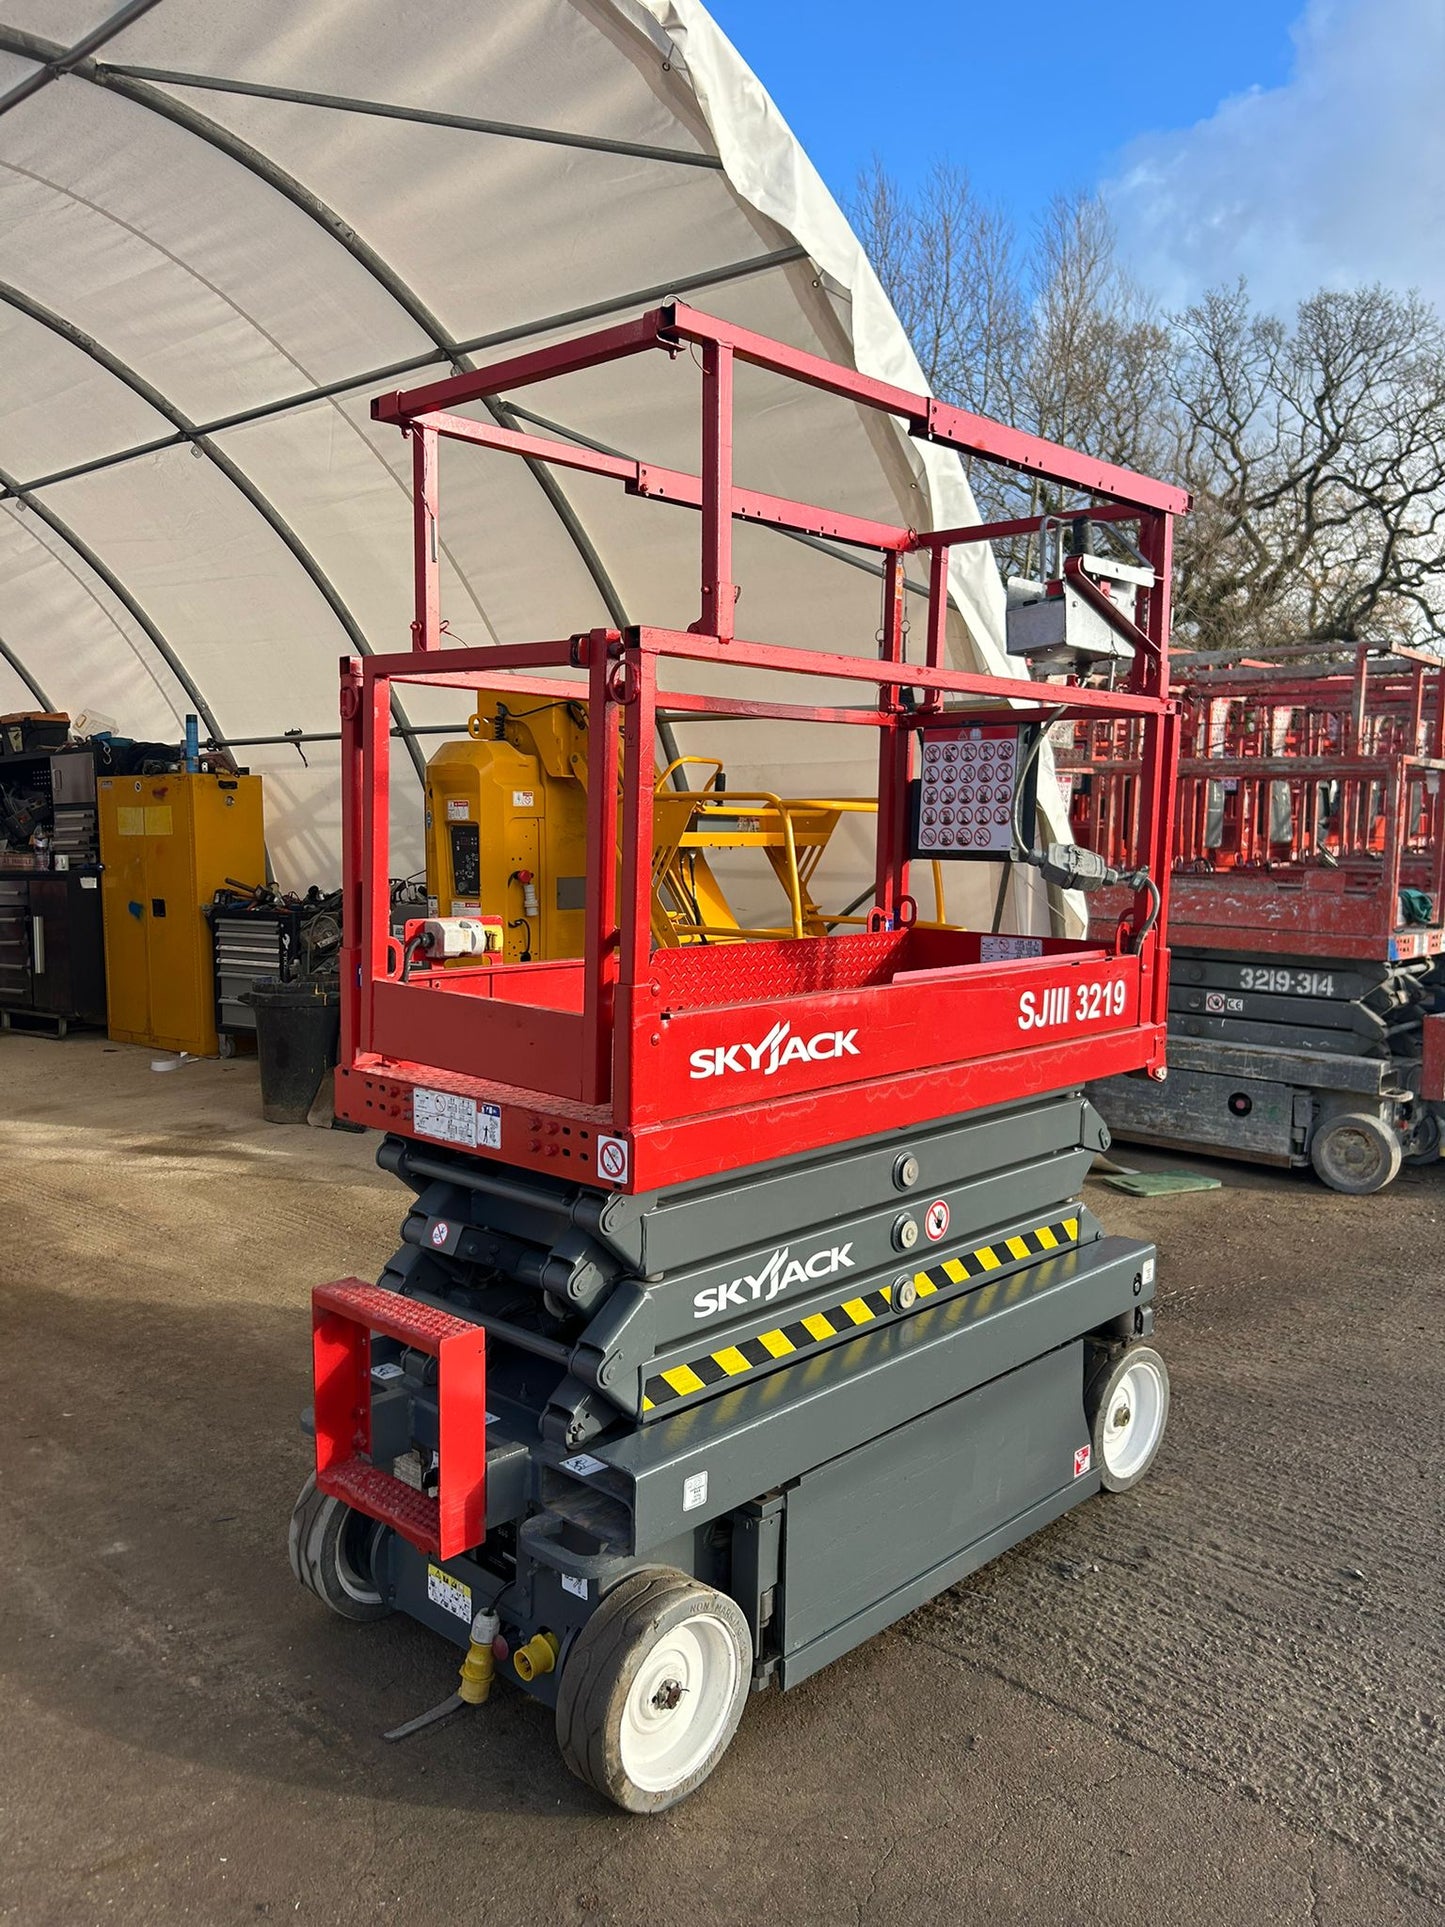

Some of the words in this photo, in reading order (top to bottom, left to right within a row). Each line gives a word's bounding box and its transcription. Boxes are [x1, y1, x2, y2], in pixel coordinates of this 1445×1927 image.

[1017, 987, 1070, 1030] SJIII
[1075, 979, 1126, 1022] 3219
[689, 1021, 861, 1079] SKYJACK
[693, 1242, 856, 1319] SKYJACK
[689, 1602, 711, 1613] NON
